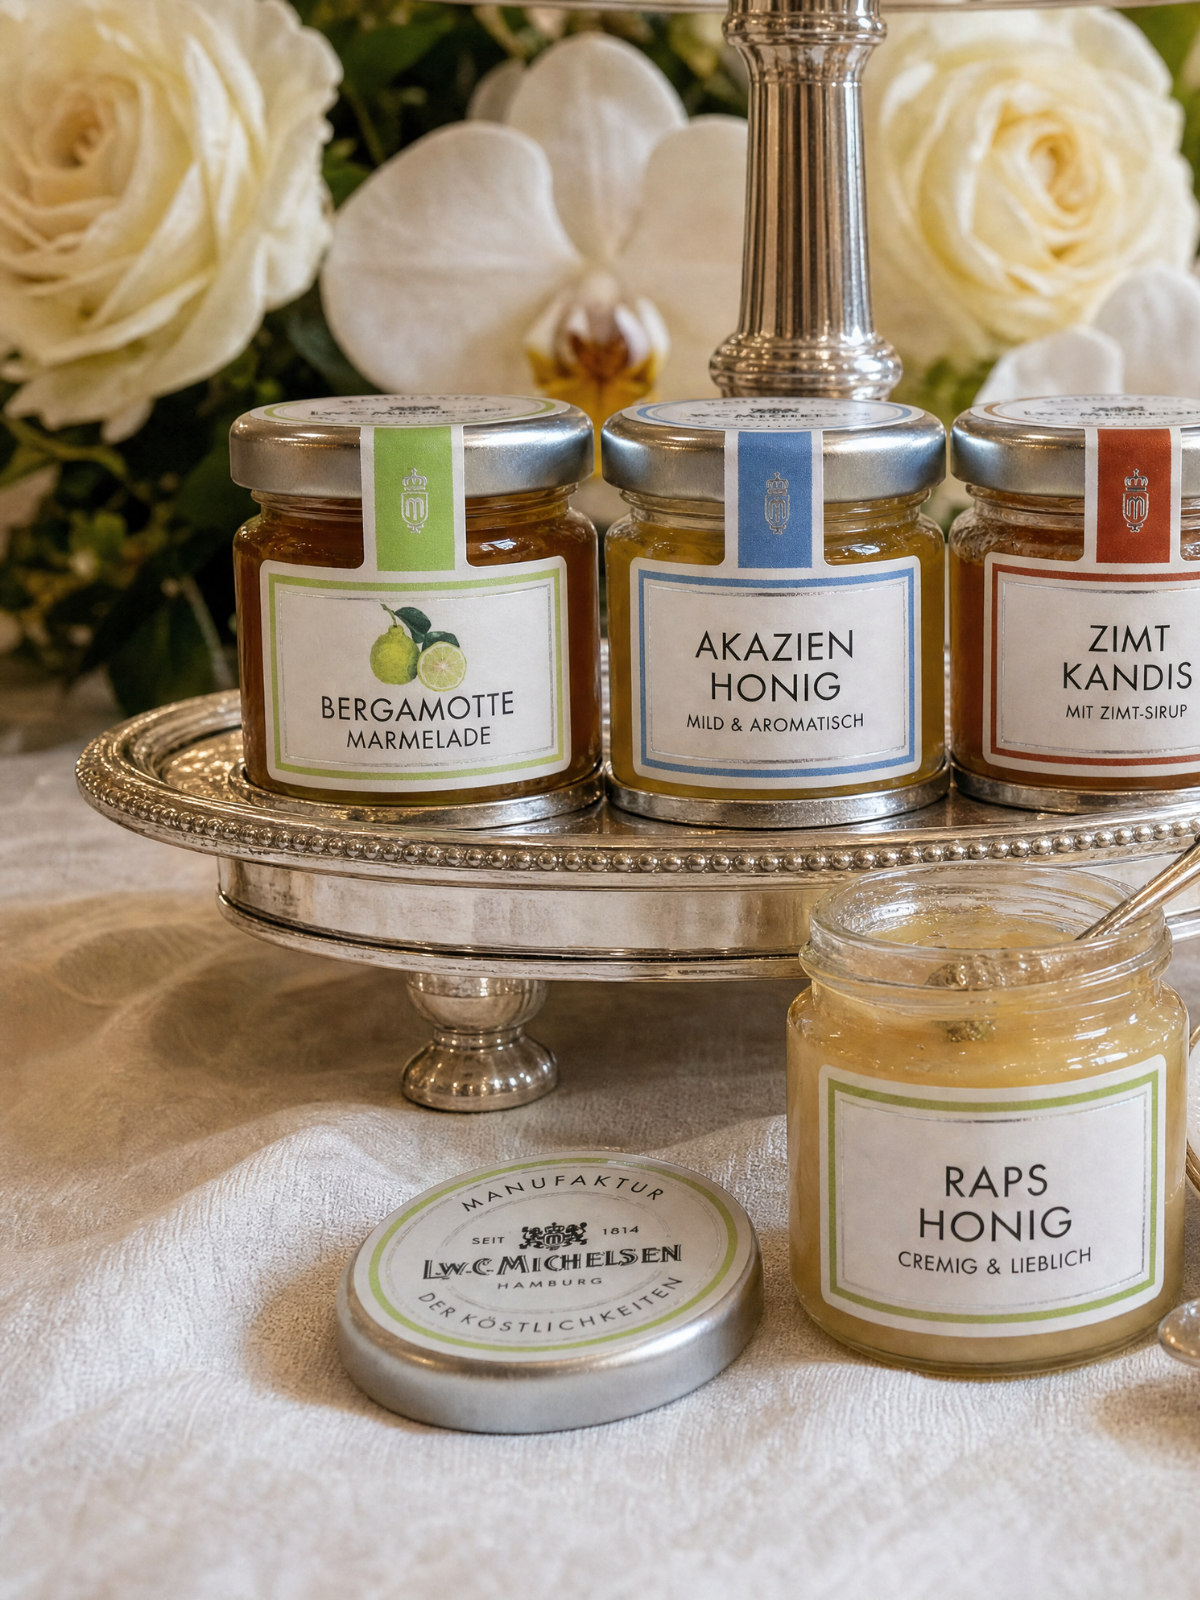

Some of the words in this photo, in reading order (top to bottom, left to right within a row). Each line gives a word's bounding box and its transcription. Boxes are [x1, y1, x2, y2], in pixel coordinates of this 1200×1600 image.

[695, 629, 853, 662] AKAZIEN
[1088, 624, 1171, 653] ZIMT
[711, 671, 841, 703] HONIG
[1063, 661, 1193, 692] KANDIS
[320, 690, 515, 723] BERGAMOTTE
[1066, 704, 1094, 720] MIT
[1099, 704, 1188, 720] ZIMT-SIRUP
[346, 725, 491, 750] MARMELADE
[686, 713, 725, 731] MILD
[730, 717, 743, 733] &
[749, 712, 864, 733] AROMATISCH
[461, 1174, 665, 1213] MANUFAKTUR
[945, 1163, 1048, 1199] RAPS
[471, 1236, 505, 1246] SEIT
[602, 1225, 640, 1236] 1814
[919, 1206, 1073, 1243] HONIG
[898, 1250, 979, 1275] CREMIG
[986, 1256, 1001, 1276] &
[1011, 1247, 1092, 1275] LIEBLICH
[497, 1277, 603, 1290] HAMBURG
[418, 1292, 456, 1318] DER
[460, 1276, 684, 1333] KÖSTLICHKEITEN
